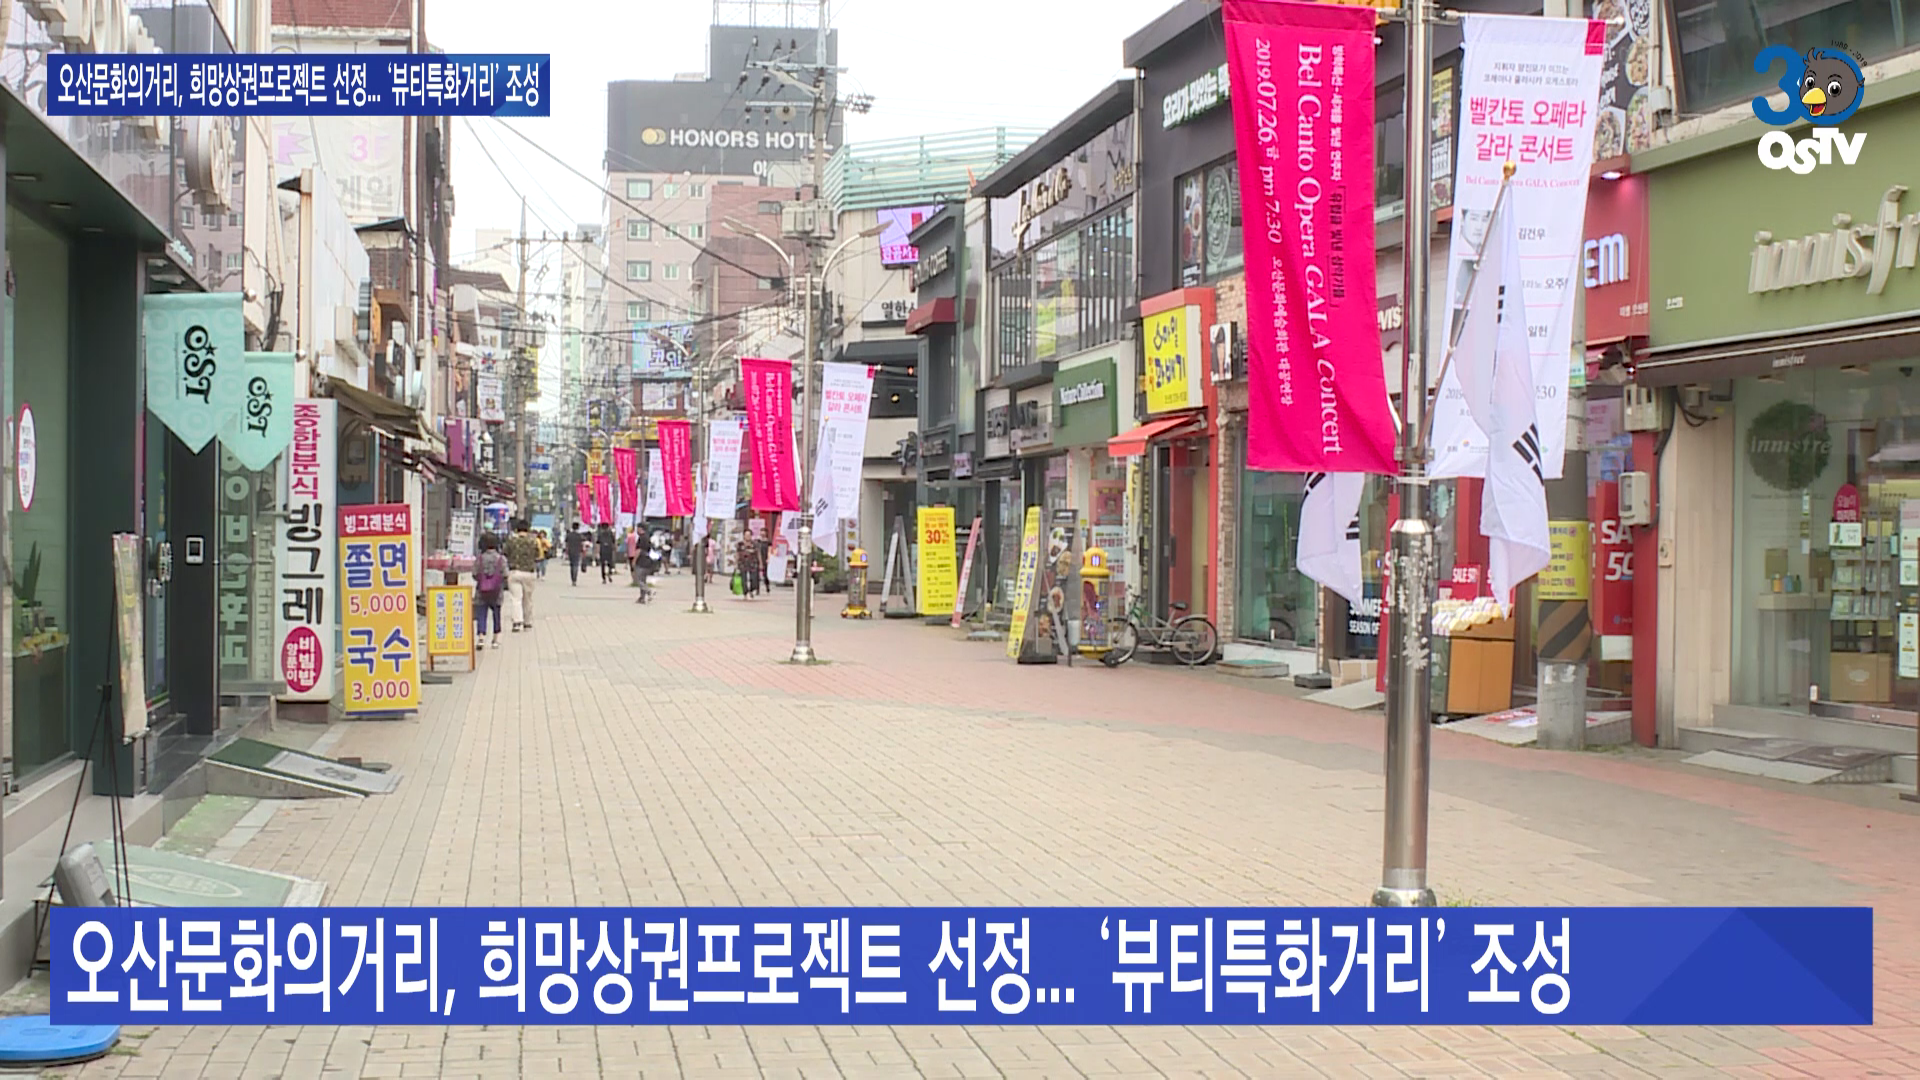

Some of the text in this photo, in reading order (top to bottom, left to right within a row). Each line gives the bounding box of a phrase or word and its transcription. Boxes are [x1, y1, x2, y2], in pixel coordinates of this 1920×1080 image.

[1162, 83, 1190, 129] 요리가
[1189, 71, 1218, 115] 맛있는
[1469, 96, 1588, 130] 벨칸토 오페라
[669, 128, 834, 151] HONORS HOTEL
[1476, 133, 1575, 165] 갈라 콘서트
[1258, 165, 1275, 197] pm
[1265, 199, 1283, 244] 7:30
[1748, 184, 1920, 295] innisfr
[1294, 43, 1344, 455] Bel Canto Opera GALA Concert
[1278, 357, 1294, 407] 대공연장
[291, 403, 321, 500] 종합분식
[344, 512, 407, 534] 빙그레분식
[282, 503, 324, 625] 빙그레
[343, 542, 407, 589] 쫄면
[350, 594, 408, 616] 5,000
[347, 627, 412, 675] 국수
[351, 680, 411, 703] 3,000
